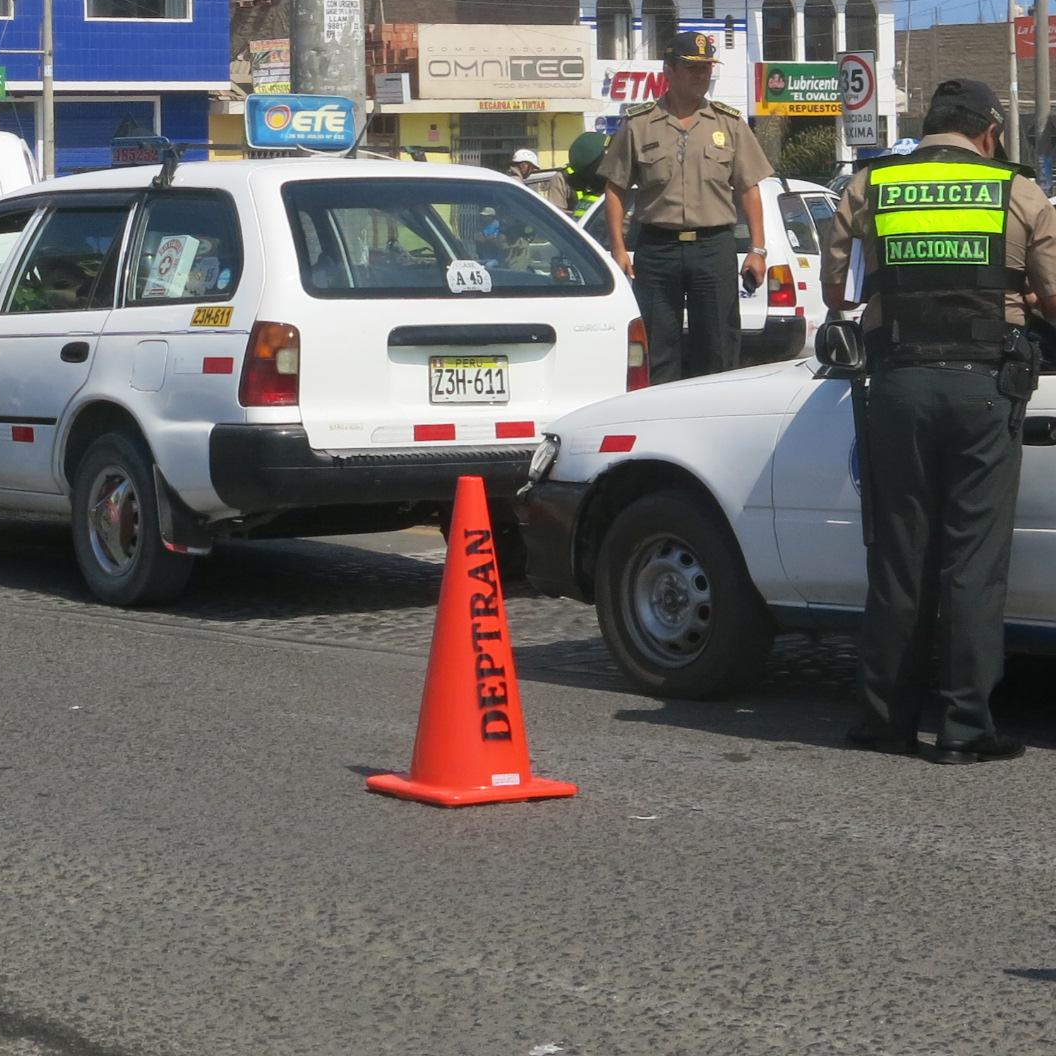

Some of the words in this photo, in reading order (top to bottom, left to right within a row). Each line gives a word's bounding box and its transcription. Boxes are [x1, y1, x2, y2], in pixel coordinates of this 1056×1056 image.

[789, 104, 842, 113] REPUESTOS
[887, 184, 993, 204] POLICIA
[890, 240, 985, 260] NACIONAL
[192, 307, 232, 325] Z3H-611
[434, 368, 506, 395] Z3H-611
[463, 527, 513, 743] DEPTRAN
